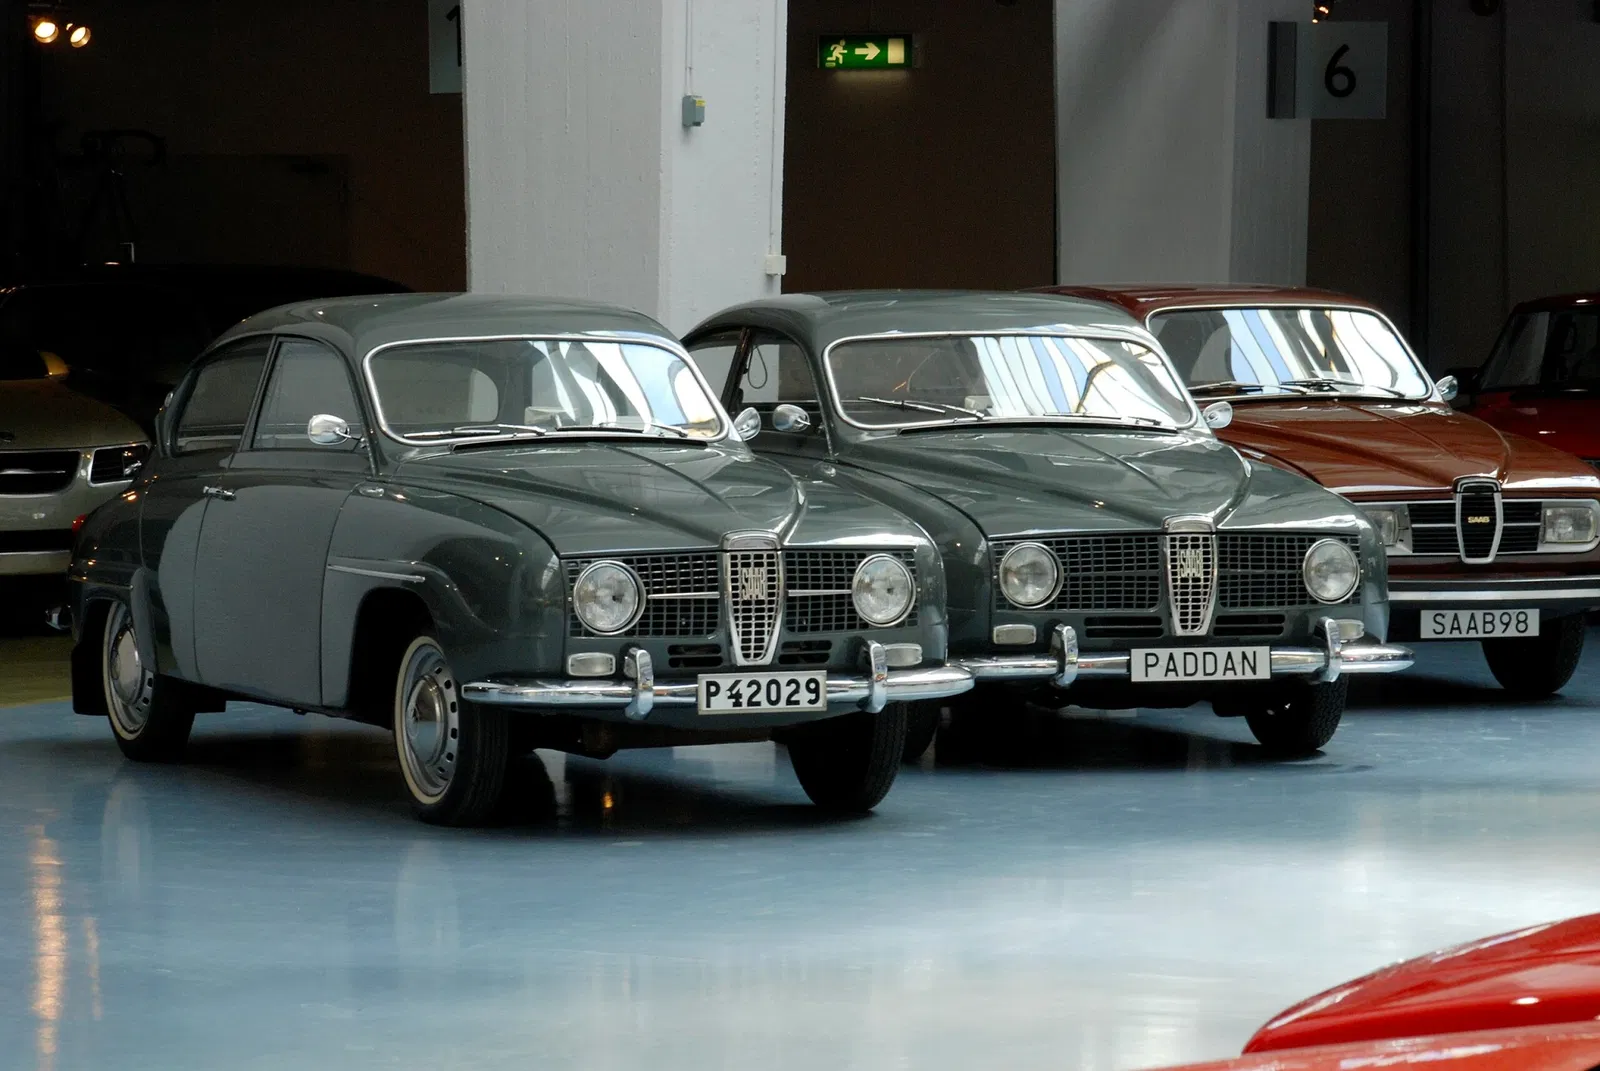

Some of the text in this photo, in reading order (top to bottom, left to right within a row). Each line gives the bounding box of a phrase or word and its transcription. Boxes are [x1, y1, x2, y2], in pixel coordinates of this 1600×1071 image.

[1325, 44, 1357, 98] 6
[1467, 516, 1490, 524] SAAB
[742, 567, 766, 600] SAAB
[1432, 611, 1529, 635] SAAB98
[1145, 651, 1257, 678] PADDAN
[705, 677, 821, 709] P42029
